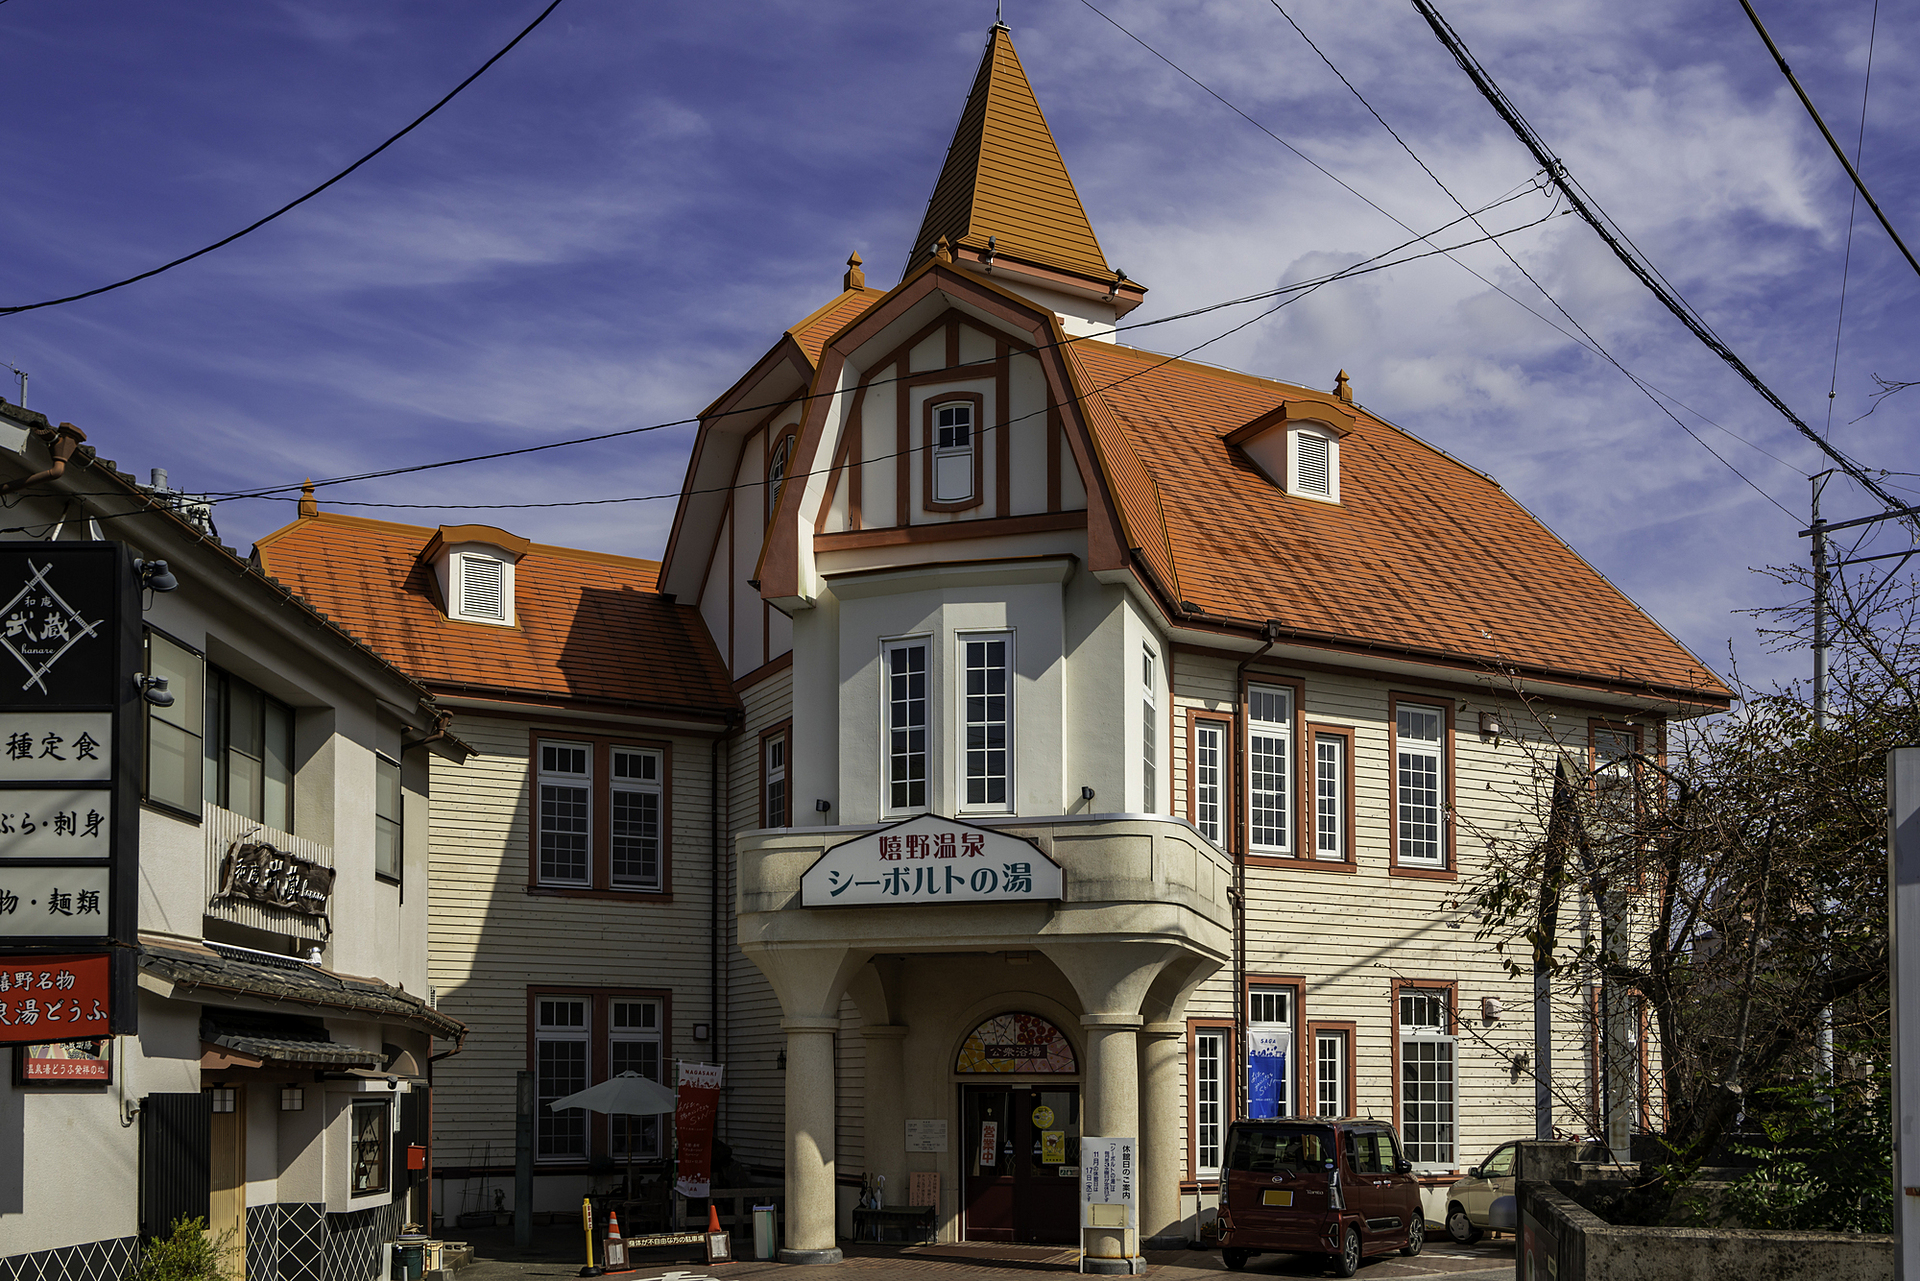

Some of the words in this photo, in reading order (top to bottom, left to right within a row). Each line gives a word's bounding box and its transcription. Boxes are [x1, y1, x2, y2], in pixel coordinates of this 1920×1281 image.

[24, 595, 53, 608] 和庵
[5, 610, 70, 643] 武蔵
[21, 643, 56, 654] hanare
[878, 832, 986, 862] 嬉野温泉
[828, 862, 1032, 898] シーボルトの湯
[989, 1046, 1042, 1058] 公衆浴場
[685, 1069, 718, 1077] NAGASAKI
[981, 1125, 996, 1164] 営業中
[1122, 1144, 1131, 1200] 休館日のご案内
